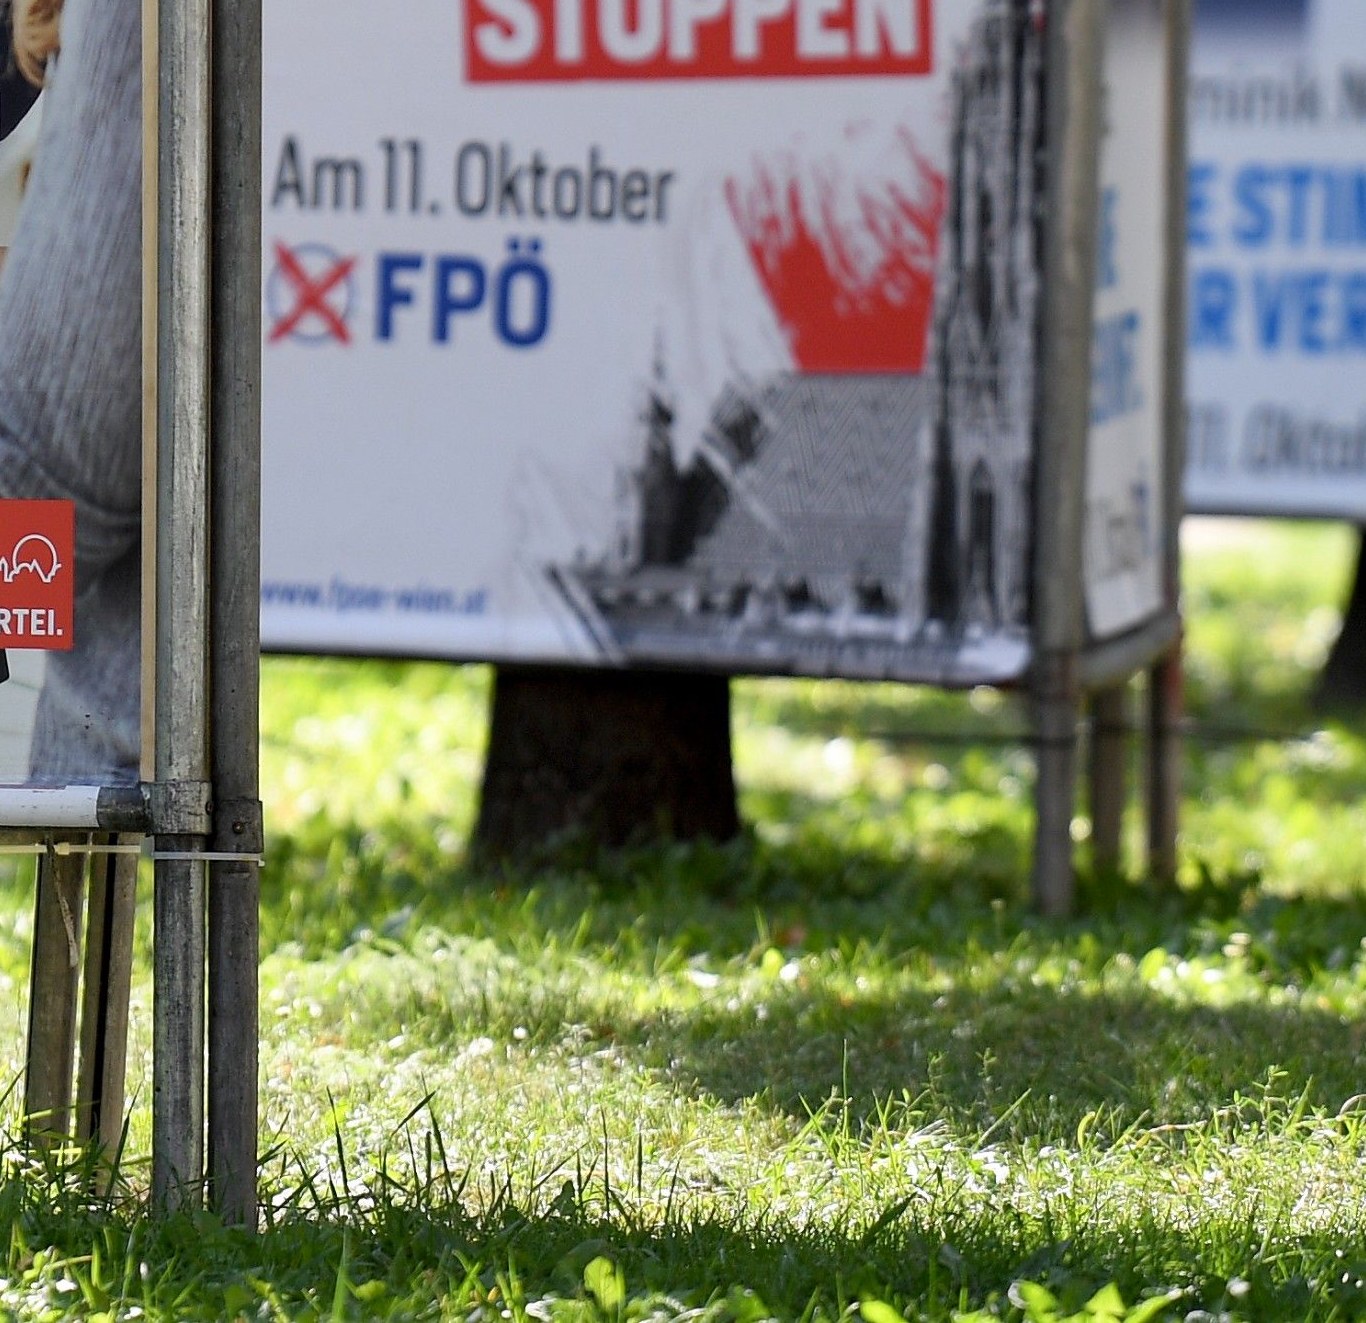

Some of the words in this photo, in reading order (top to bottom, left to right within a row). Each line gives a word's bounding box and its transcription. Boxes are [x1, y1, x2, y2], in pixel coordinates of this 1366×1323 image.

[271, 135, 364, 211] Am
[378, 137, 441, 215] 11.
[455, 141, 675, 222] Oktober
[376, 236, 552, 350] FPÖ
